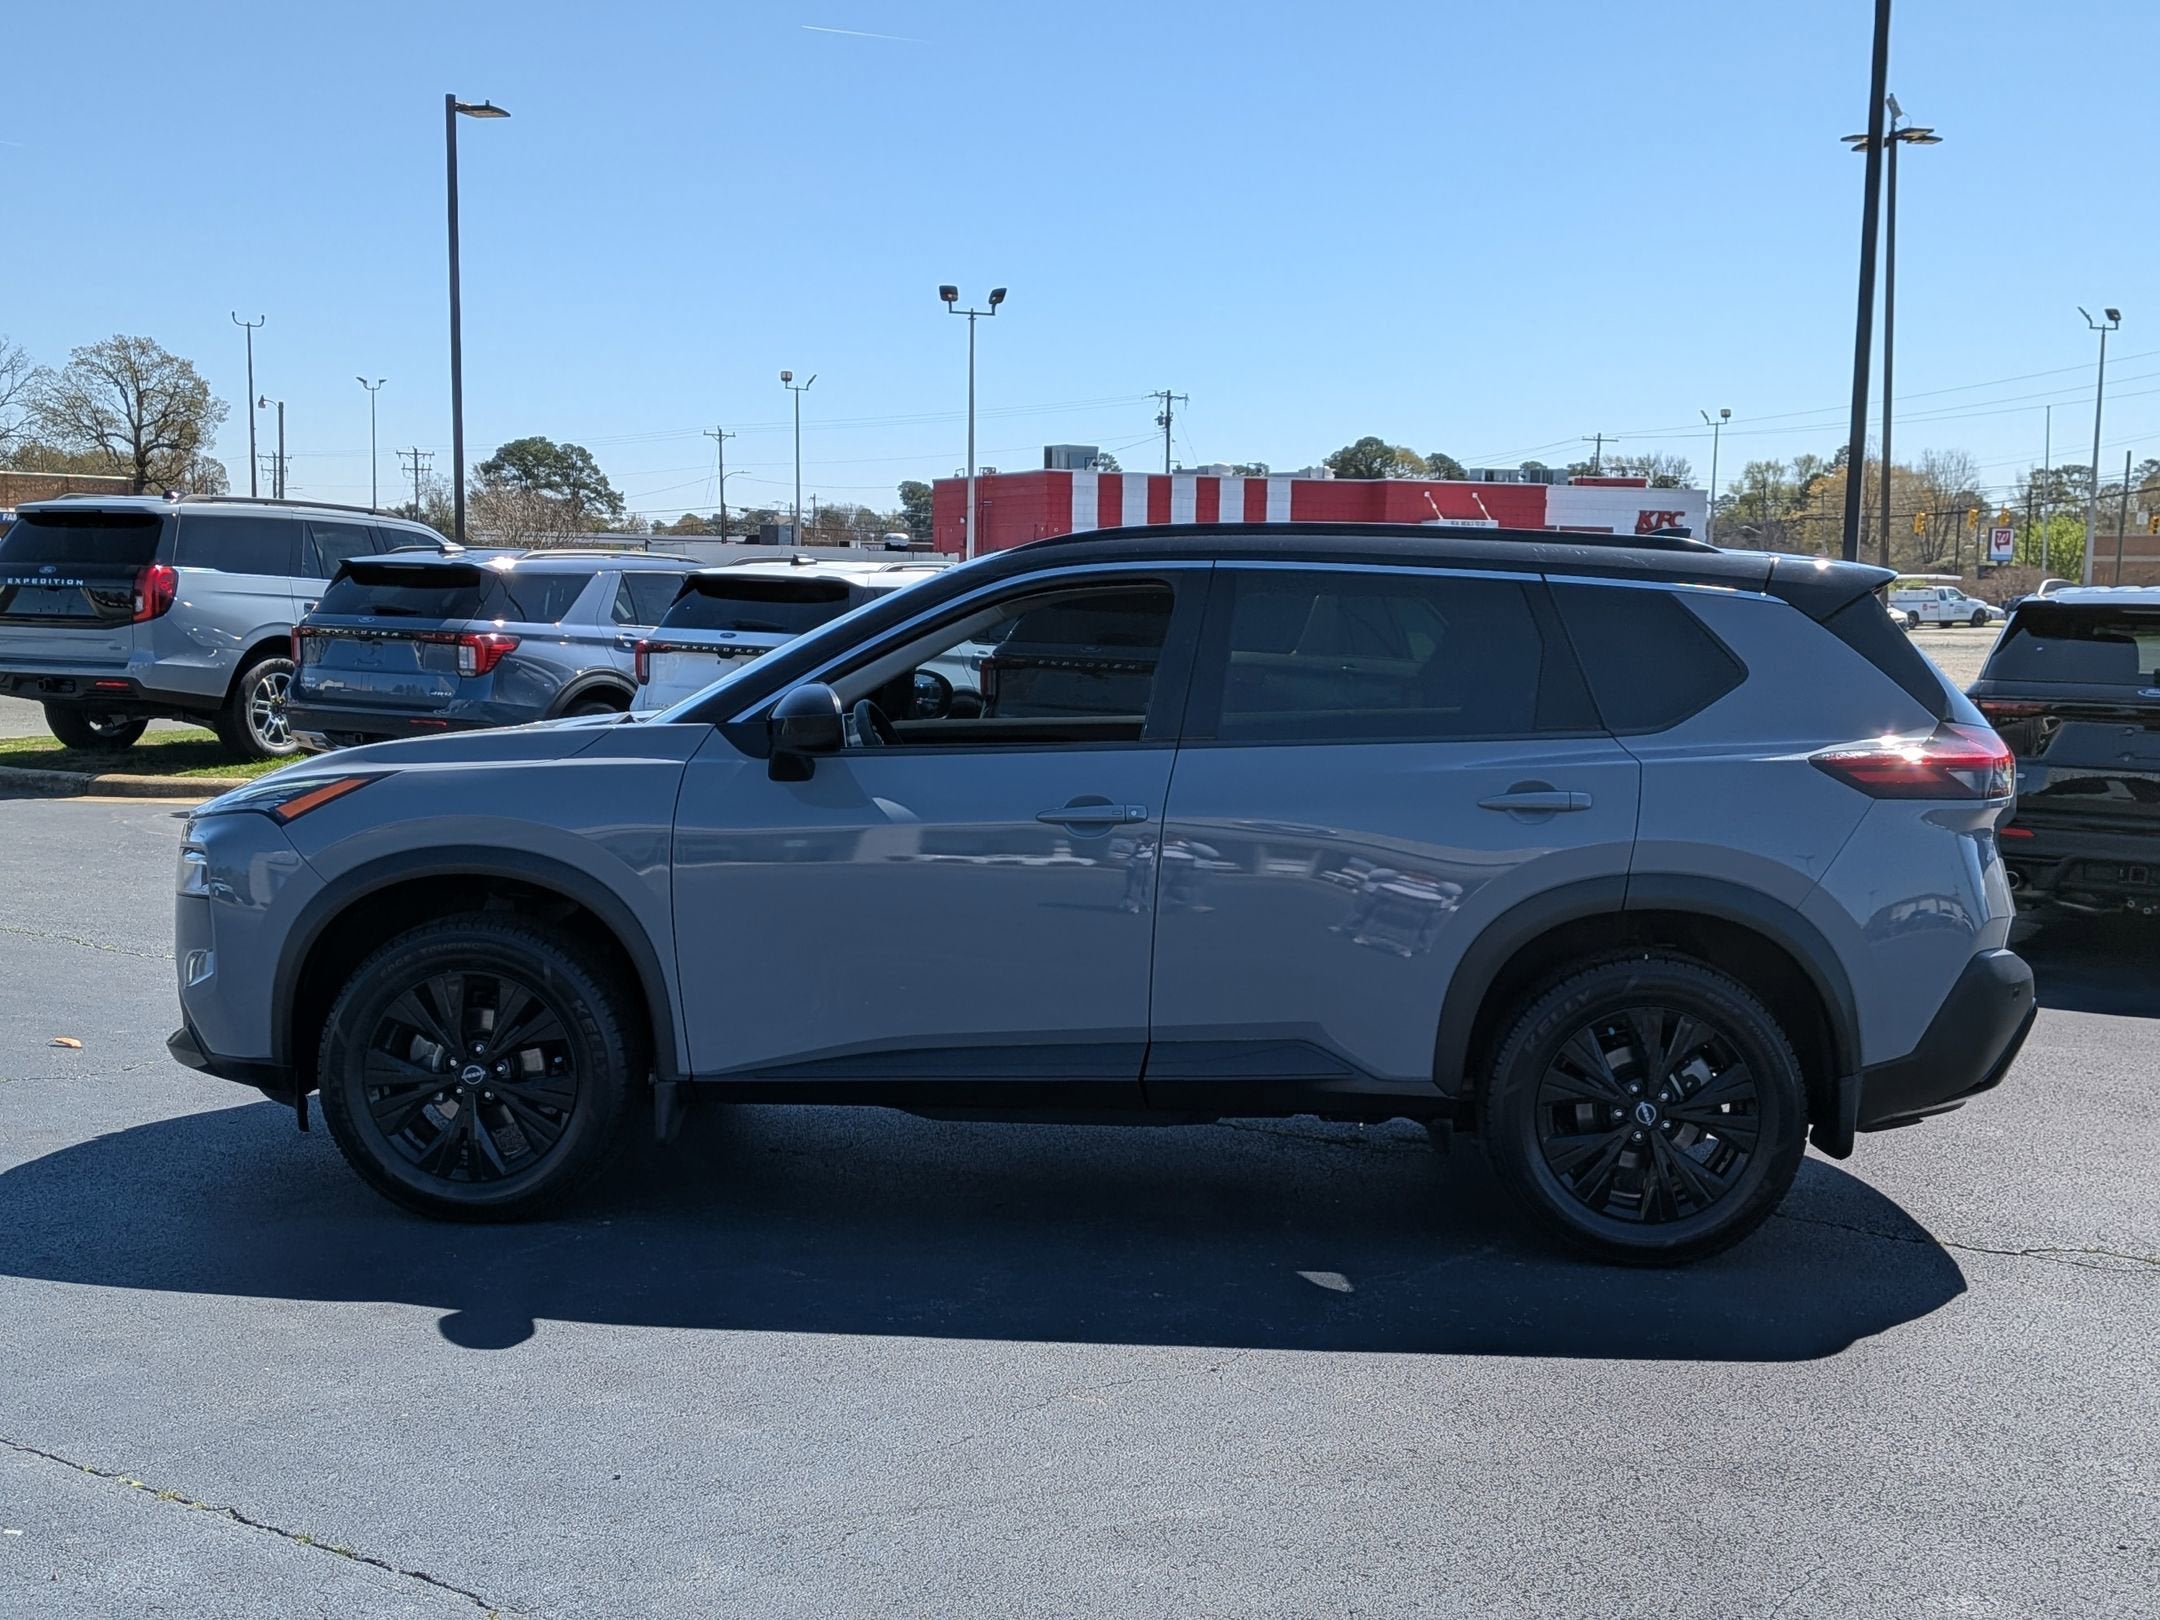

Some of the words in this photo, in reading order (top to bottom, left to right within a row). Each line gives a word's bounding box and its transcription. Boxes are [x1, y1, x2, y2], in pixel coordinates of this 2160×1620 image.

[1637, 510, 1686, 528] KFC
[7, 577, 84, 586] EXPEDITION
[681, 644, 767, 656] EXPLORER
[1037, 658, 1137, 670] EXPLORER
[1524, 988, 1592, 1054] KELLY
